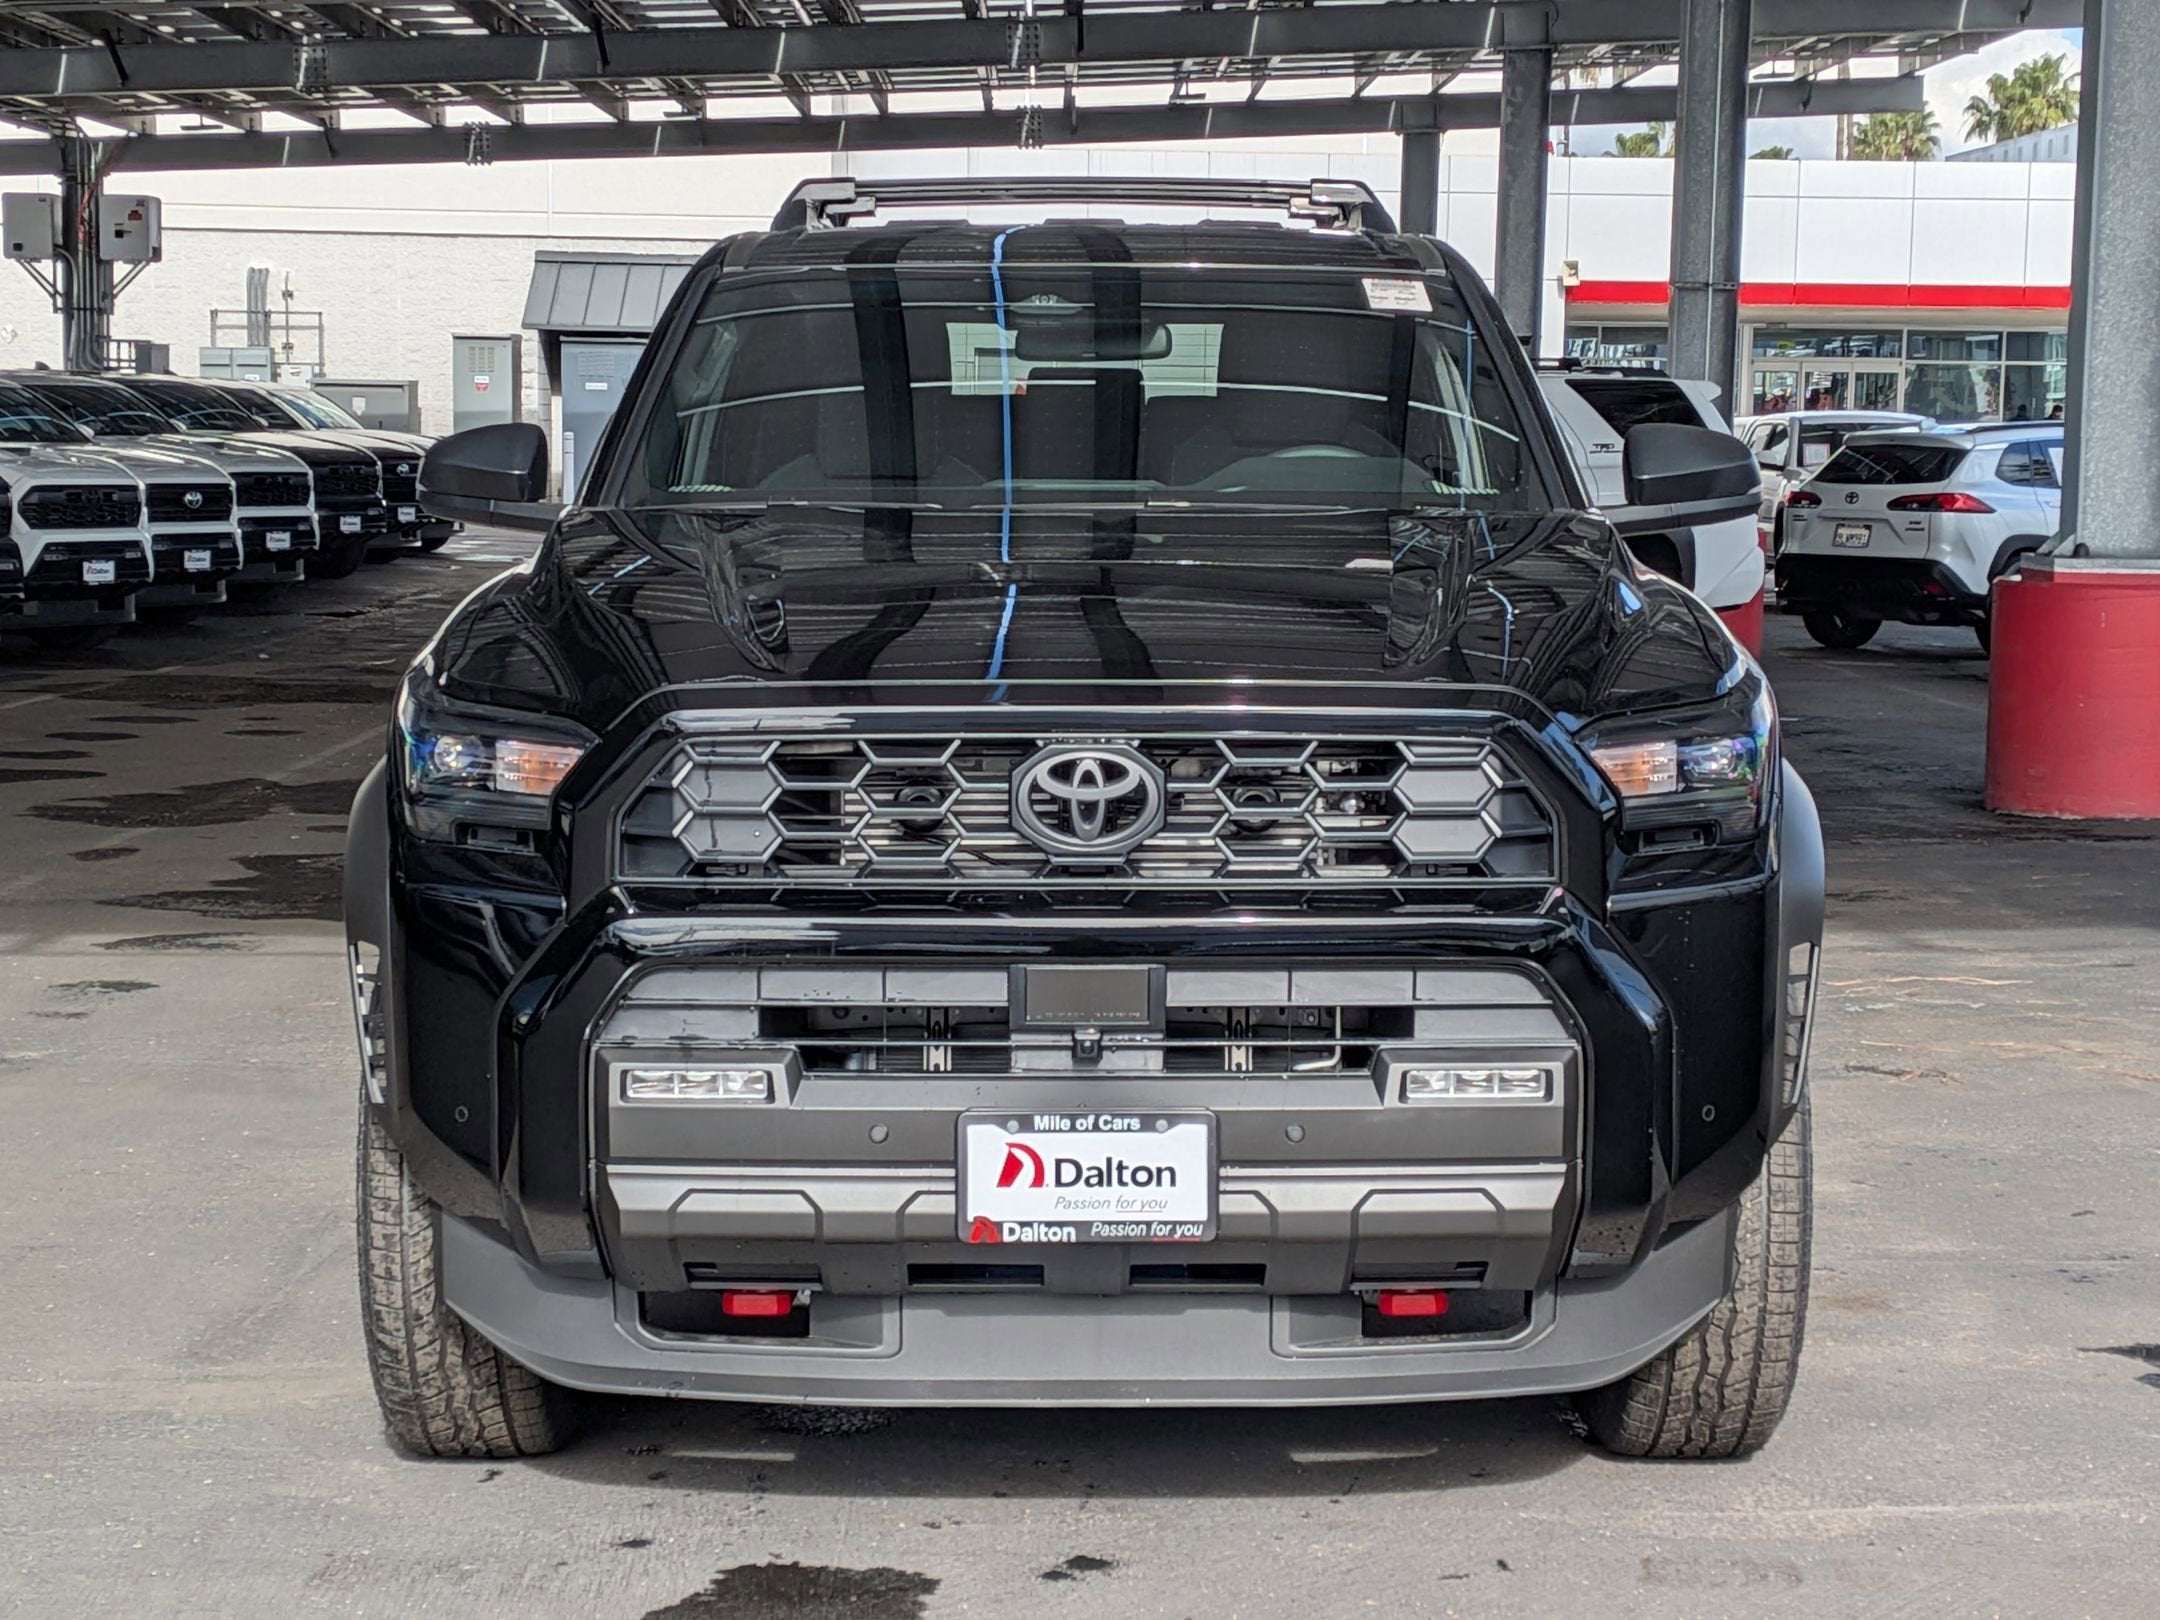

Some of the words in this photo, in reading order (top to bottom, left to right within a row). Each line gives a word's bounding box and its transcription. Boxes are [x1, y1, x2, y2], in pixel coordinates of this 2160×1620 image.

[1033, 1115, 1070, 1131] Mile
[1076, 1115, 1095, 1131] of
[1098, 1115, 1141, 1131] Cars
[1054, 1157, 1177, 1188] Dalton
[1054, 1196, 1111, 1210] Passion
[1115, 1196, 1137, 1210] for
[1140, 1199, 1168, 1212] you
[1003, 1222, 1077, 1242] Dalton
[1090, 1222, 1147, 1237] Passion
[1149, 1222, 1173, 1237] for
[1174, 1223, 1203, 1239] you
